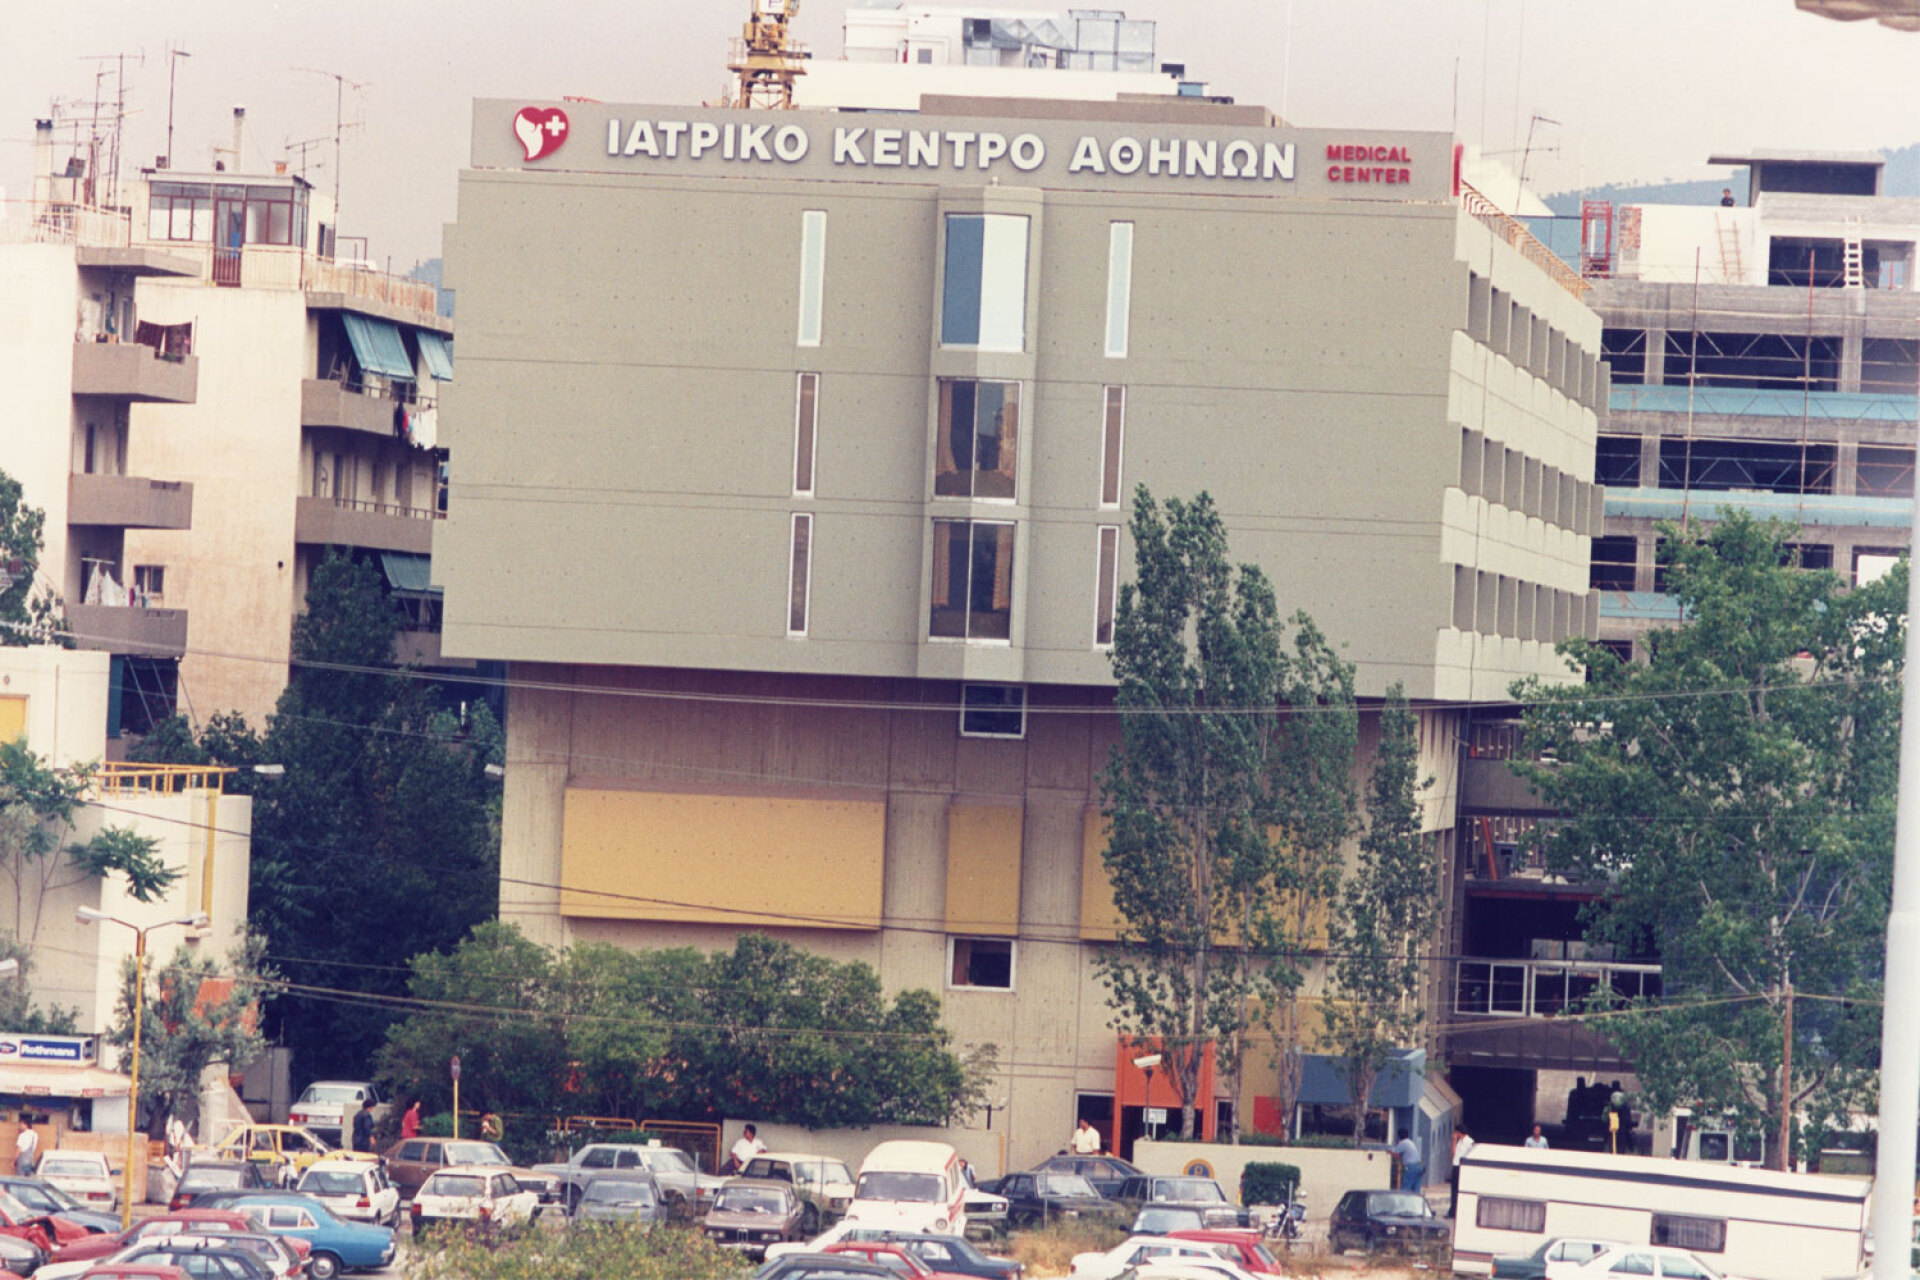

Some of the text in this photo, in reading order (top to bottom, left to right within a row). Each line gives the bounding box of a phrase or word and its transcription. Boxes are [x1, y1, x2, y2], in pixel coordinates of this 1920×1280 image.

[607, 119, 1296, 180] ΙΑΤΡΙΚΟ ΚΕΝΤΡΟ ΑΘΗΝΩΝ
[1326, 144, 1411, 163] MEDICAL
[1327, 165, 1410, 184] CENTER
